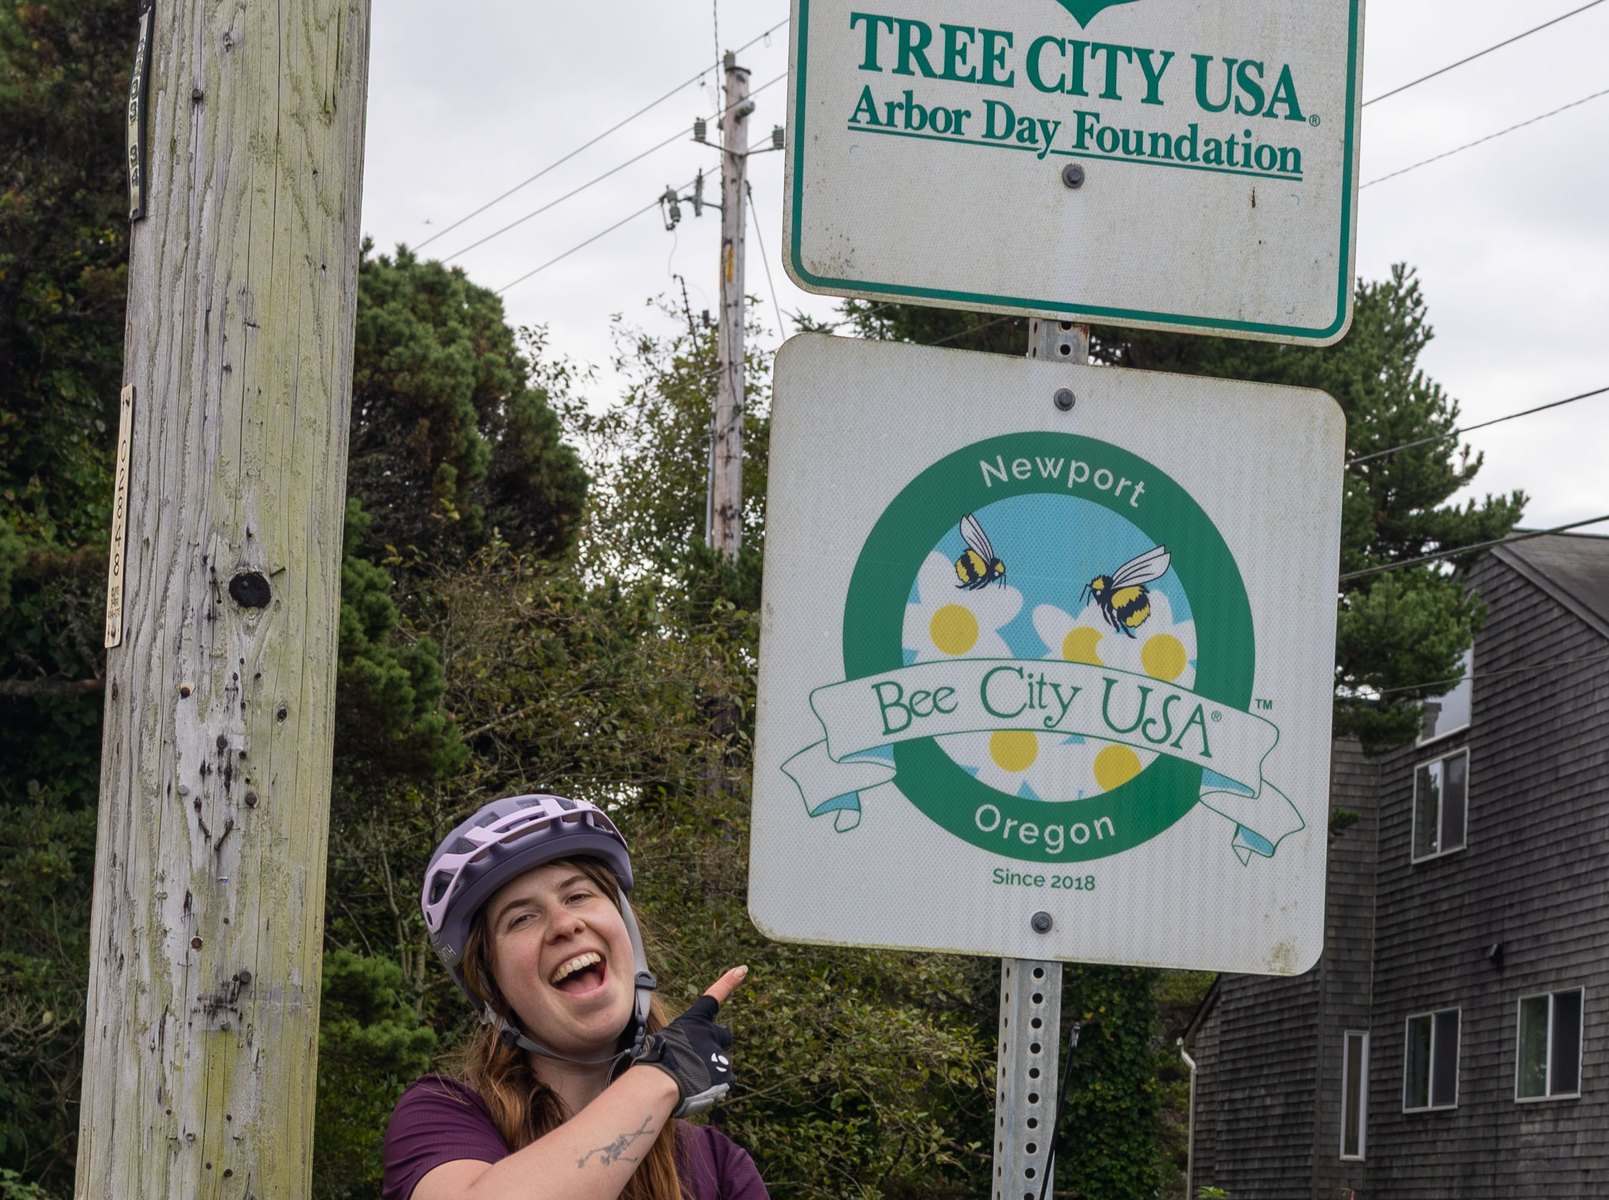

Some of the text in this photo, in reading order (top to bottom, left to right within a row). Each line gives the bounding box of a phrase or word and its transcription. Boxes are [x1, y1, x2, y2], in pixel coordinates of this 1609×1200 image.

[850, 12, 1015, 88] TREE
[1026, 35, 1175, 106] CITY
[849, 84, 1302, 175] Arbor Day Foundation
[979, 455, 1147, 508] Newport
[871, 680, 958, 736] Bee
[980, 666, 1083, 729] City
[974, 803, 1116, 854] Oregon
[992, 867, 1096, 891] Since 2018
